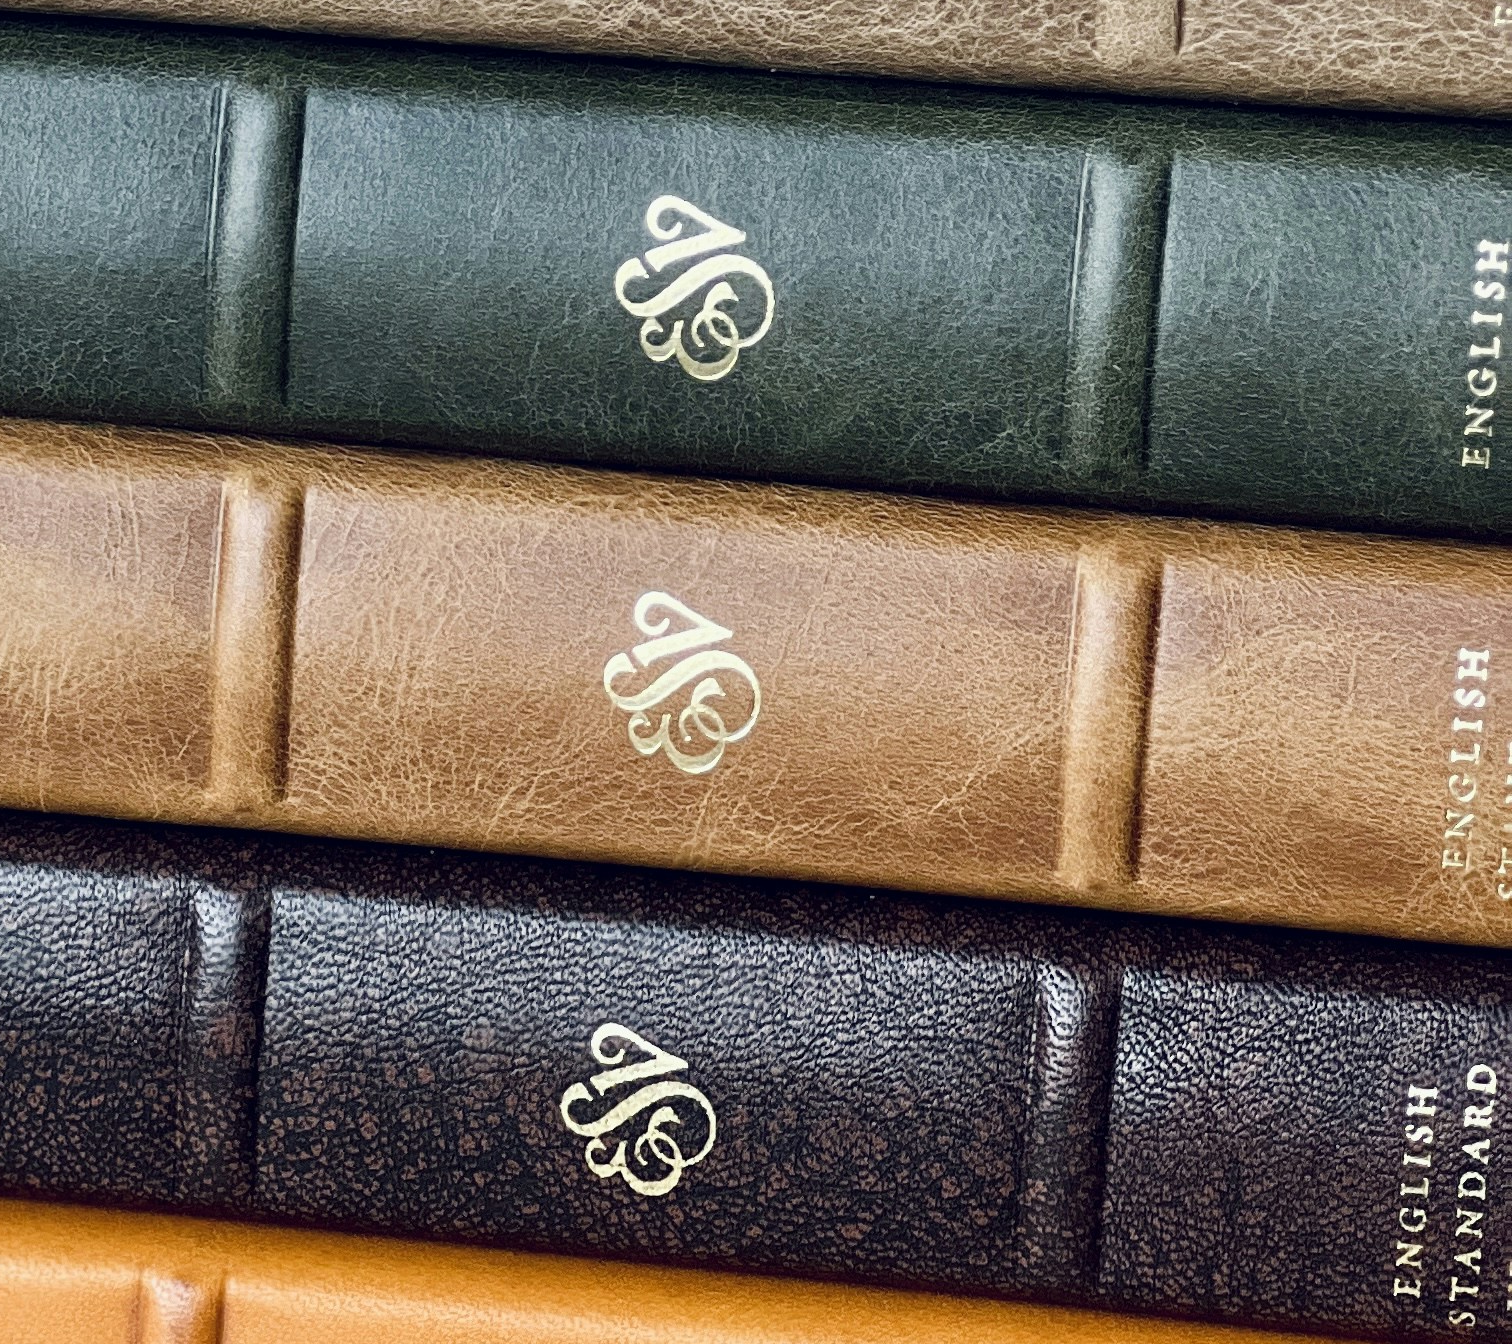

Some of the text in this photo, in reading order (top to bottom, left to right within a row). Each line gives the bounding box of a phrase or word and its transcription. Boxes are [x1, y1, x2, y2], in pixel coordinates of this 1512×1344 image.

[1461, 238, 1509, 469] ENGLISH
[1441, 647, 1490, 871] ENGLISH
[1393, 1084, 1439, 1299] ENGLISH
[1448, 1063, 1497, 1328] STANDARD
